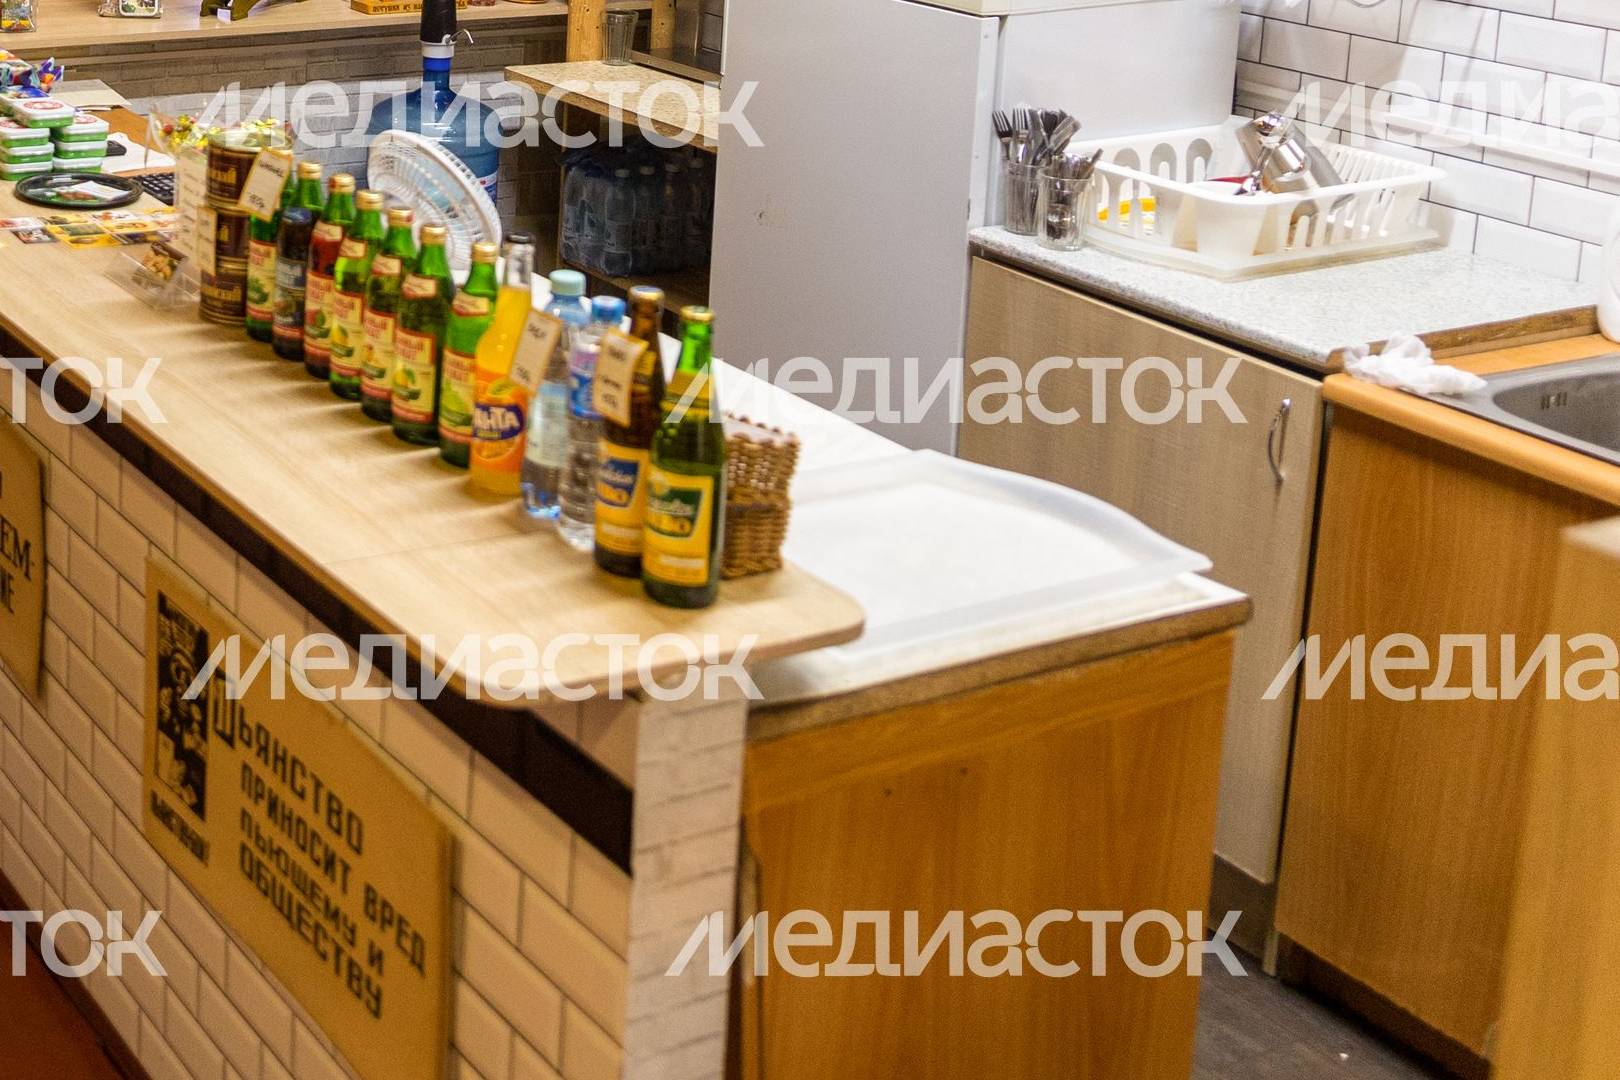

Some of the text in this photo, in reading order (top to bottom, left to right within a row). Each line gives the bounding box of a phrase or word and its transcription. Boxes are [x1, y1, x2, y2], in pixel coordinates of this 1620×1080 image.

[211, 667, 366, 859] ПЬЯНСТВО
[239, 841, 384, 1020] ОБЩЕСТВУ
[240, 758, 427, 981] ПРИНОСИТ ВРЕД
[367, 942, 386, 977] И
